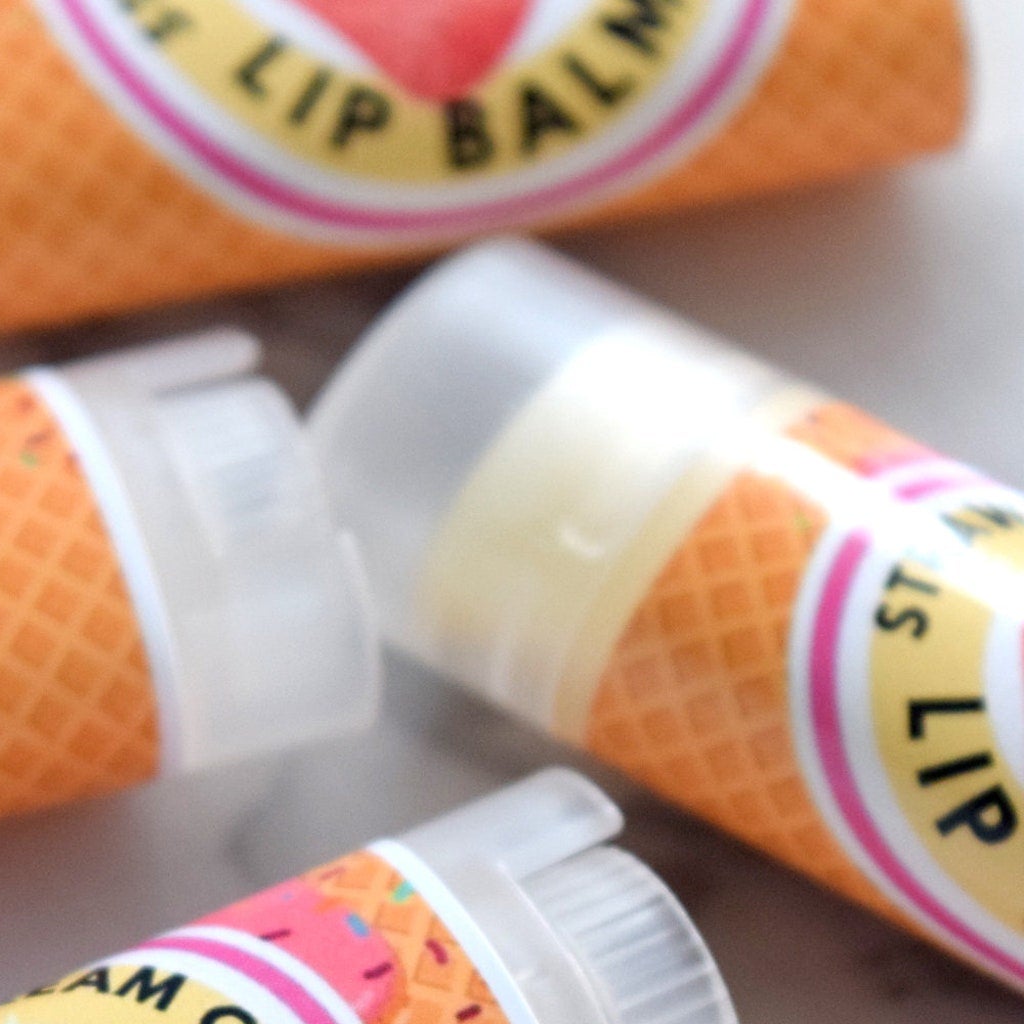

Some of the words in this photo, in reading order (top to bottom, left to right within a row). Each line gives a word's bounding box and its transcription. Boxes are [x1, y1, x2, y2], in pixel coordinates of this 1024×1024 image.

[233, 36, 392, 150] LIP
[442, 0, 672, 173] BALM
[906, 696, 1020, 848] LIP
